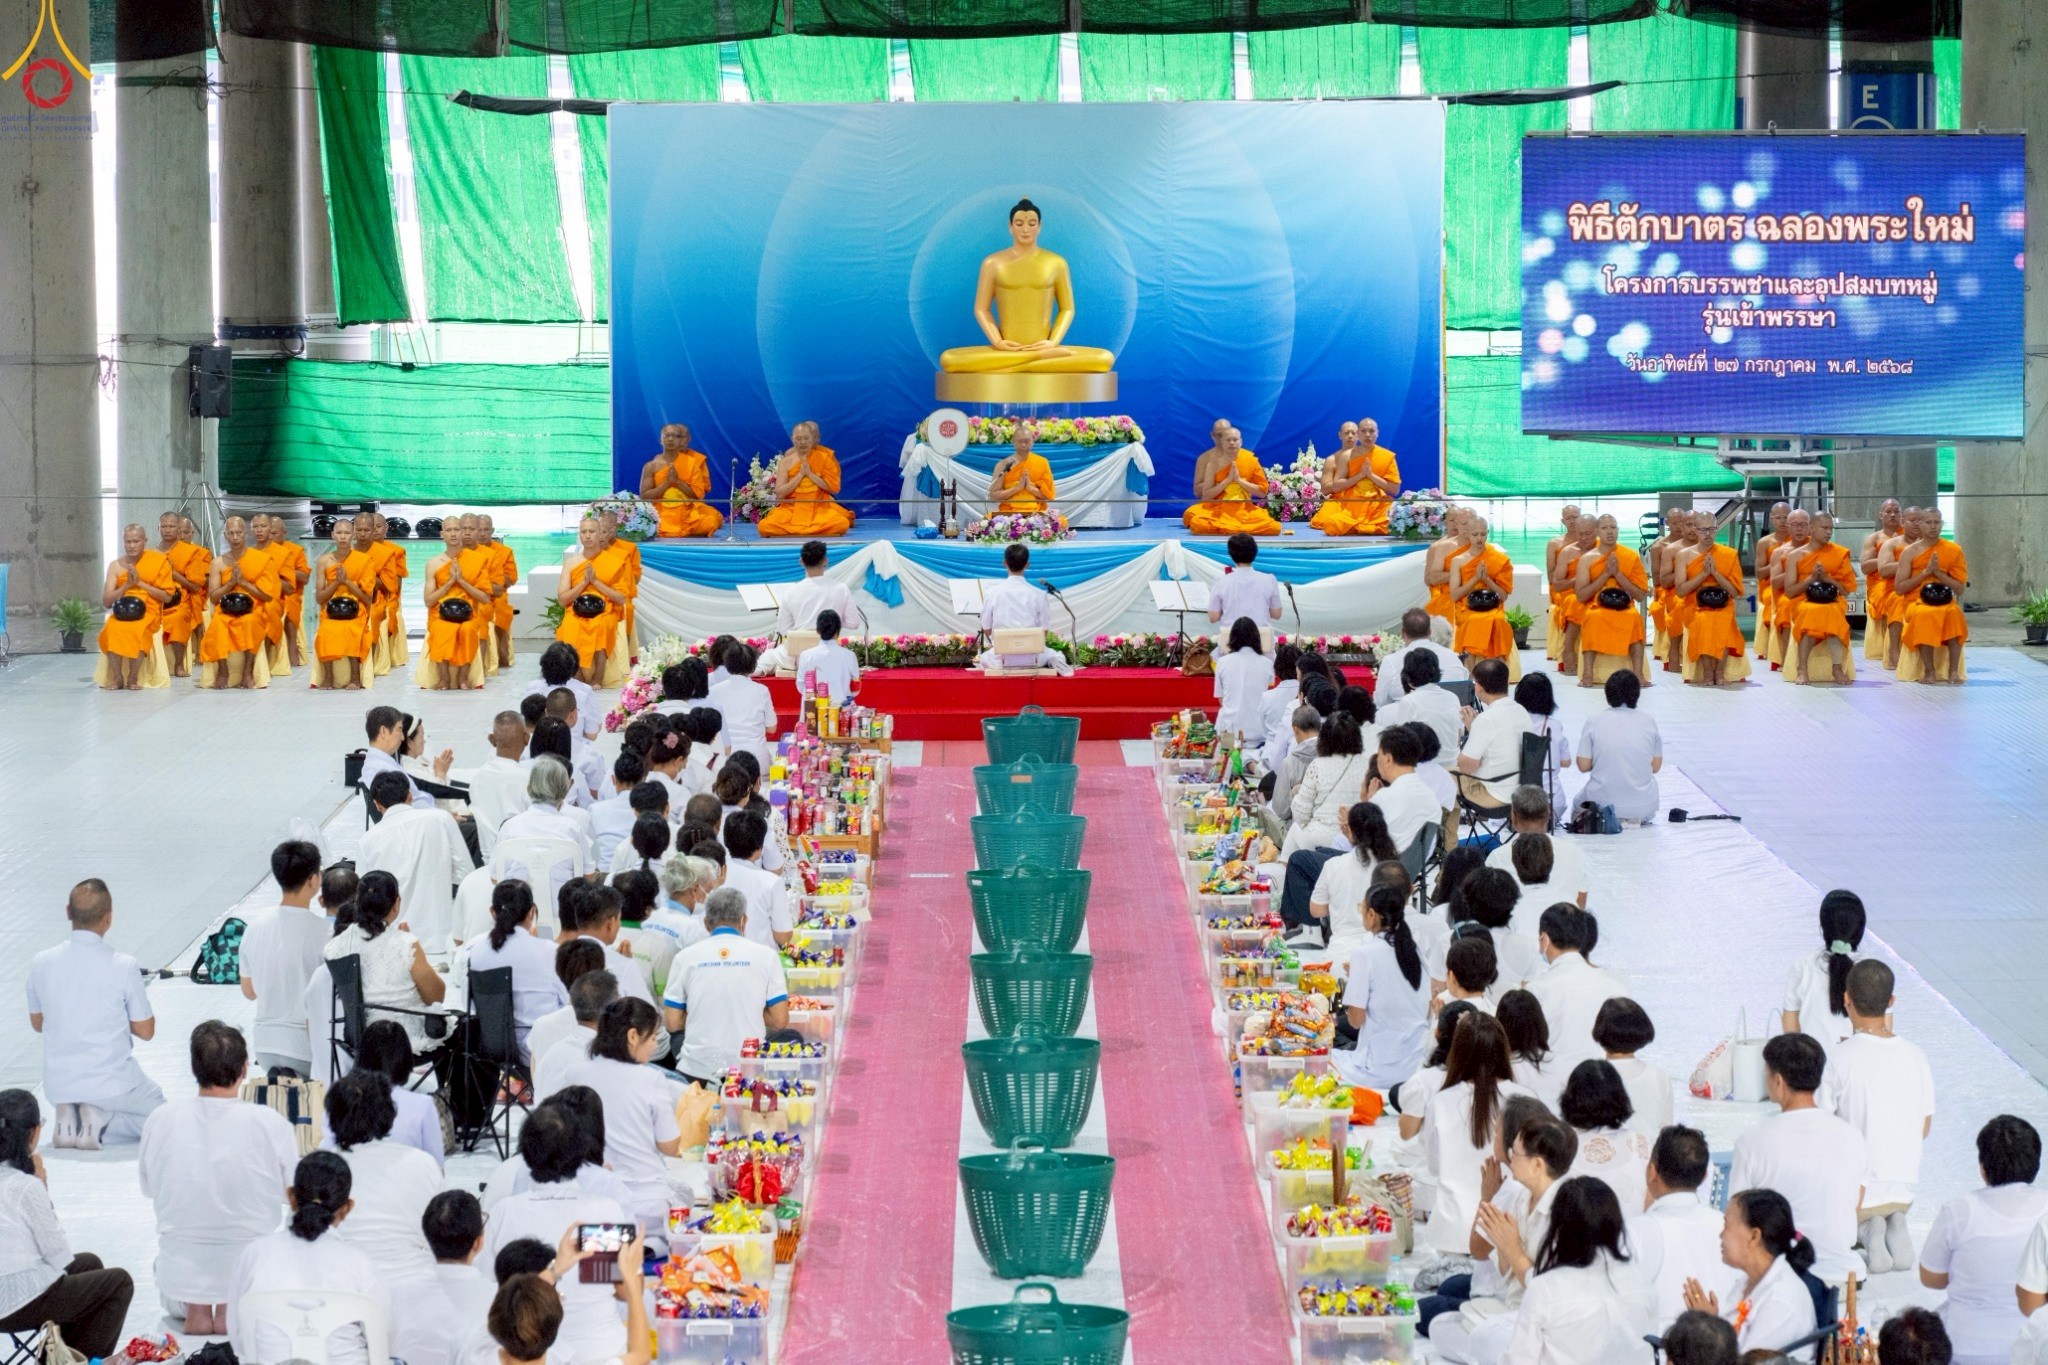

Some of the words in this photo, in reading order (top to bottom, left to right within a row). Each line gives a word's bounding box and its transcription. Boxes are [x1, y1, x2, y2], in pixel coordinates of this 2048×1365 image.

[1862, 84, 1879, 109] E
[1568, 202, 1744, 242] พิธีตักบาตร
[1755, 196, 1974, 242] ฉลองพระใหม่
[1602, 265, 1938, 304] โครงการบรรพชาและอุปสมบทหมู่
[1701, 302, 1836, 334] รุ่นเข้าพรรษา
[1627, 348, 1709, 373] วันอาทิตย์ที่
[1714, 357, 1740, 373] ๒๗
[1745, 357, 1817, 379] กรกฎาคม
[1827, 356, 1861, 374] พ.ศ.
[1866, 357, 1914, 374] ๒๕๖๘
